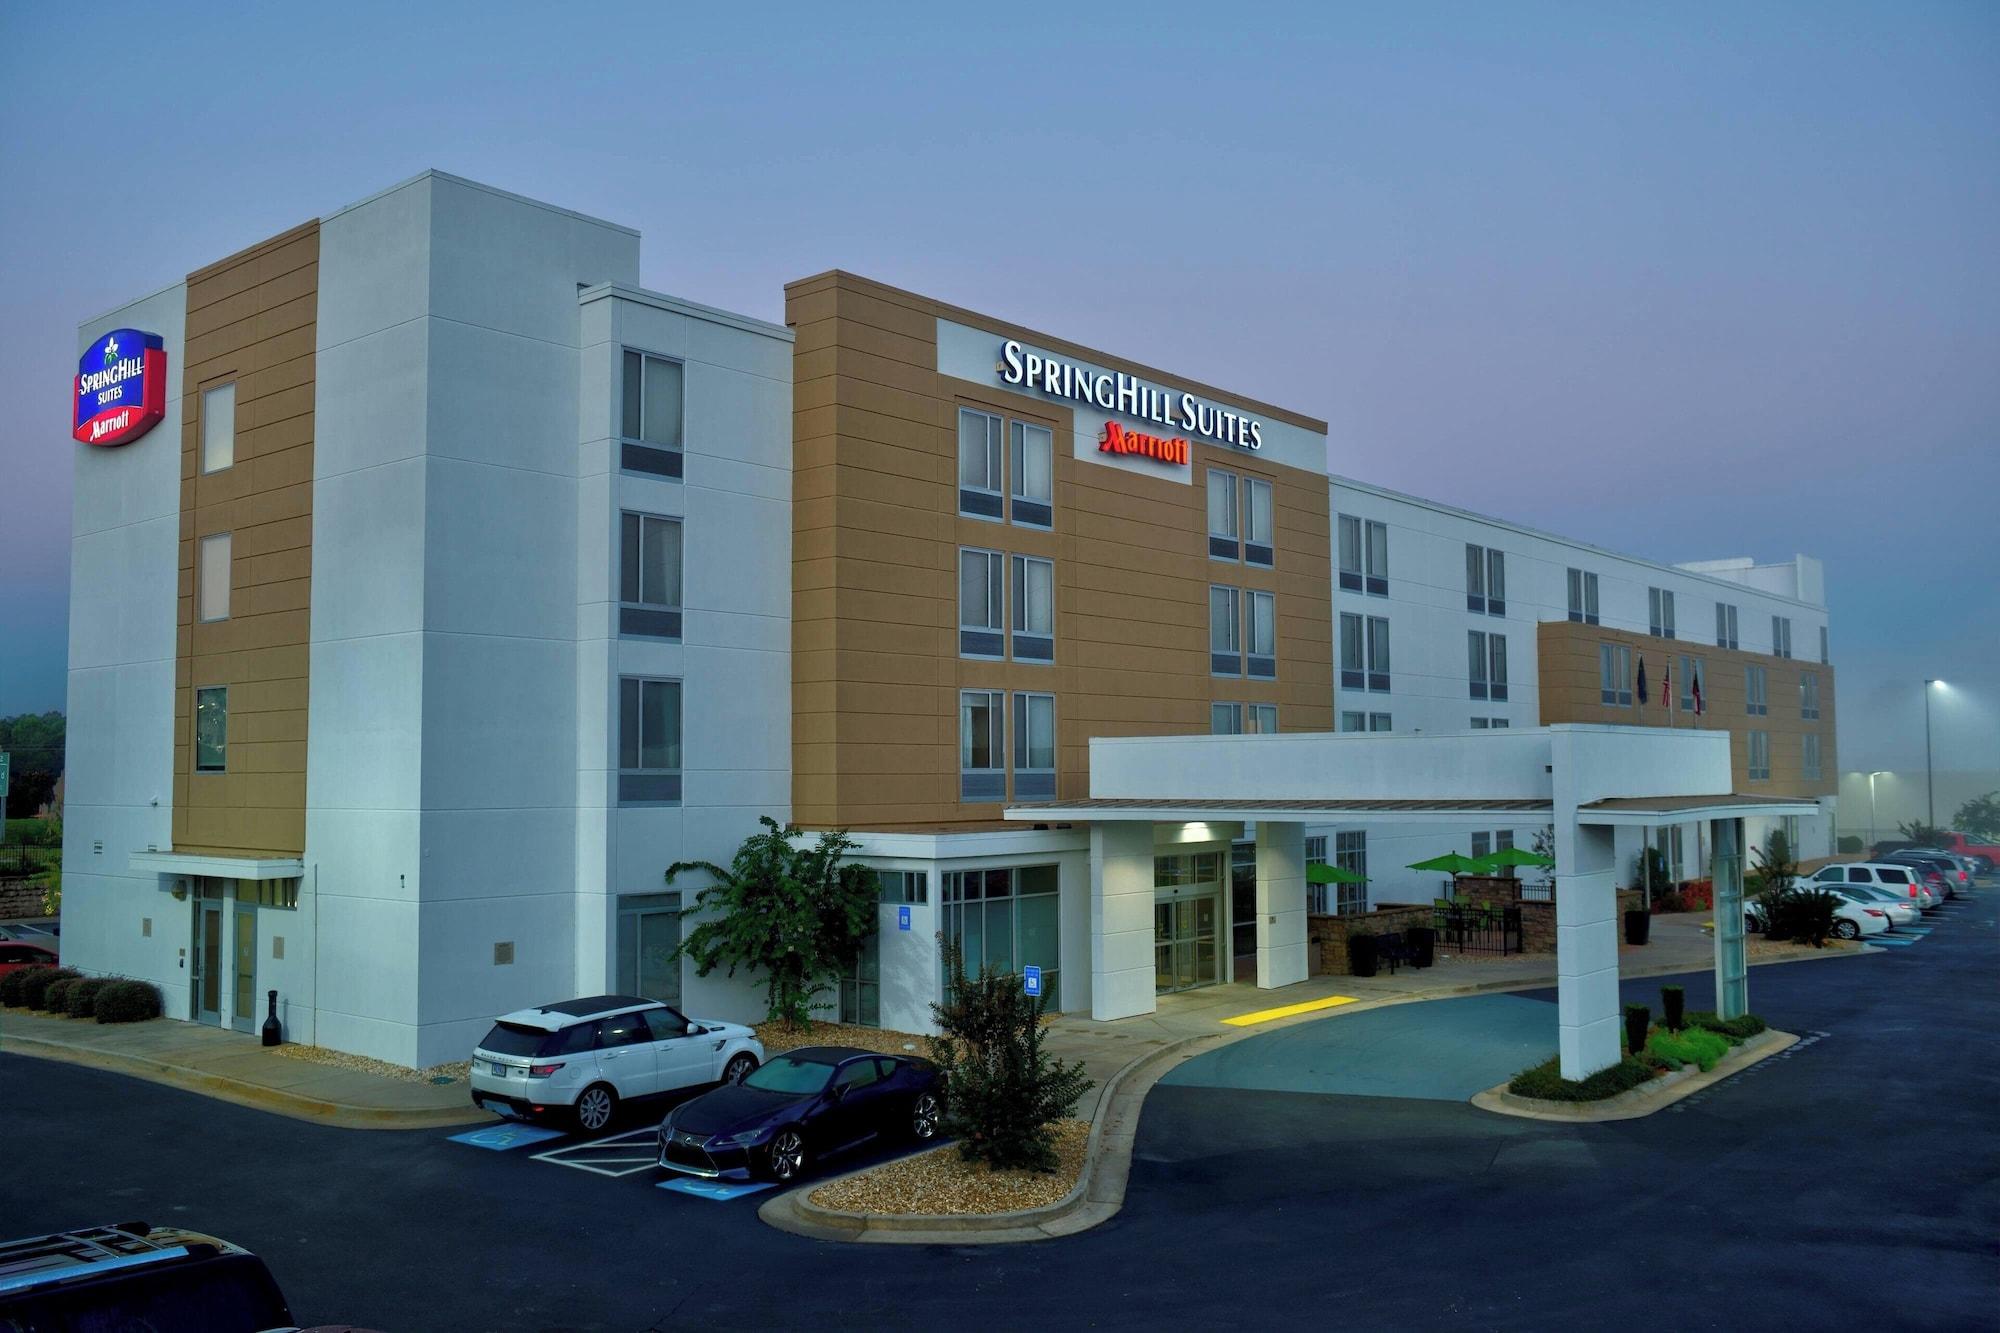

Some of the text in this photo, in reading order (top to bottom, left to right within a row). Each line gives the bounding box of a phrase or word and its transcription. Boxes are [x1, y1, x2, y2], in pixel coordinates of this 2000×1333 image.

[80, 357, 143, 395] SPRINGHILL
[97, 385, 123, 405] SUITES
[1001, 340, 1262, 450] SPRINGHILL SUITES
[89, 410, 129, 442] Marriott
[1099, 421, 1188, 465] Marriott
